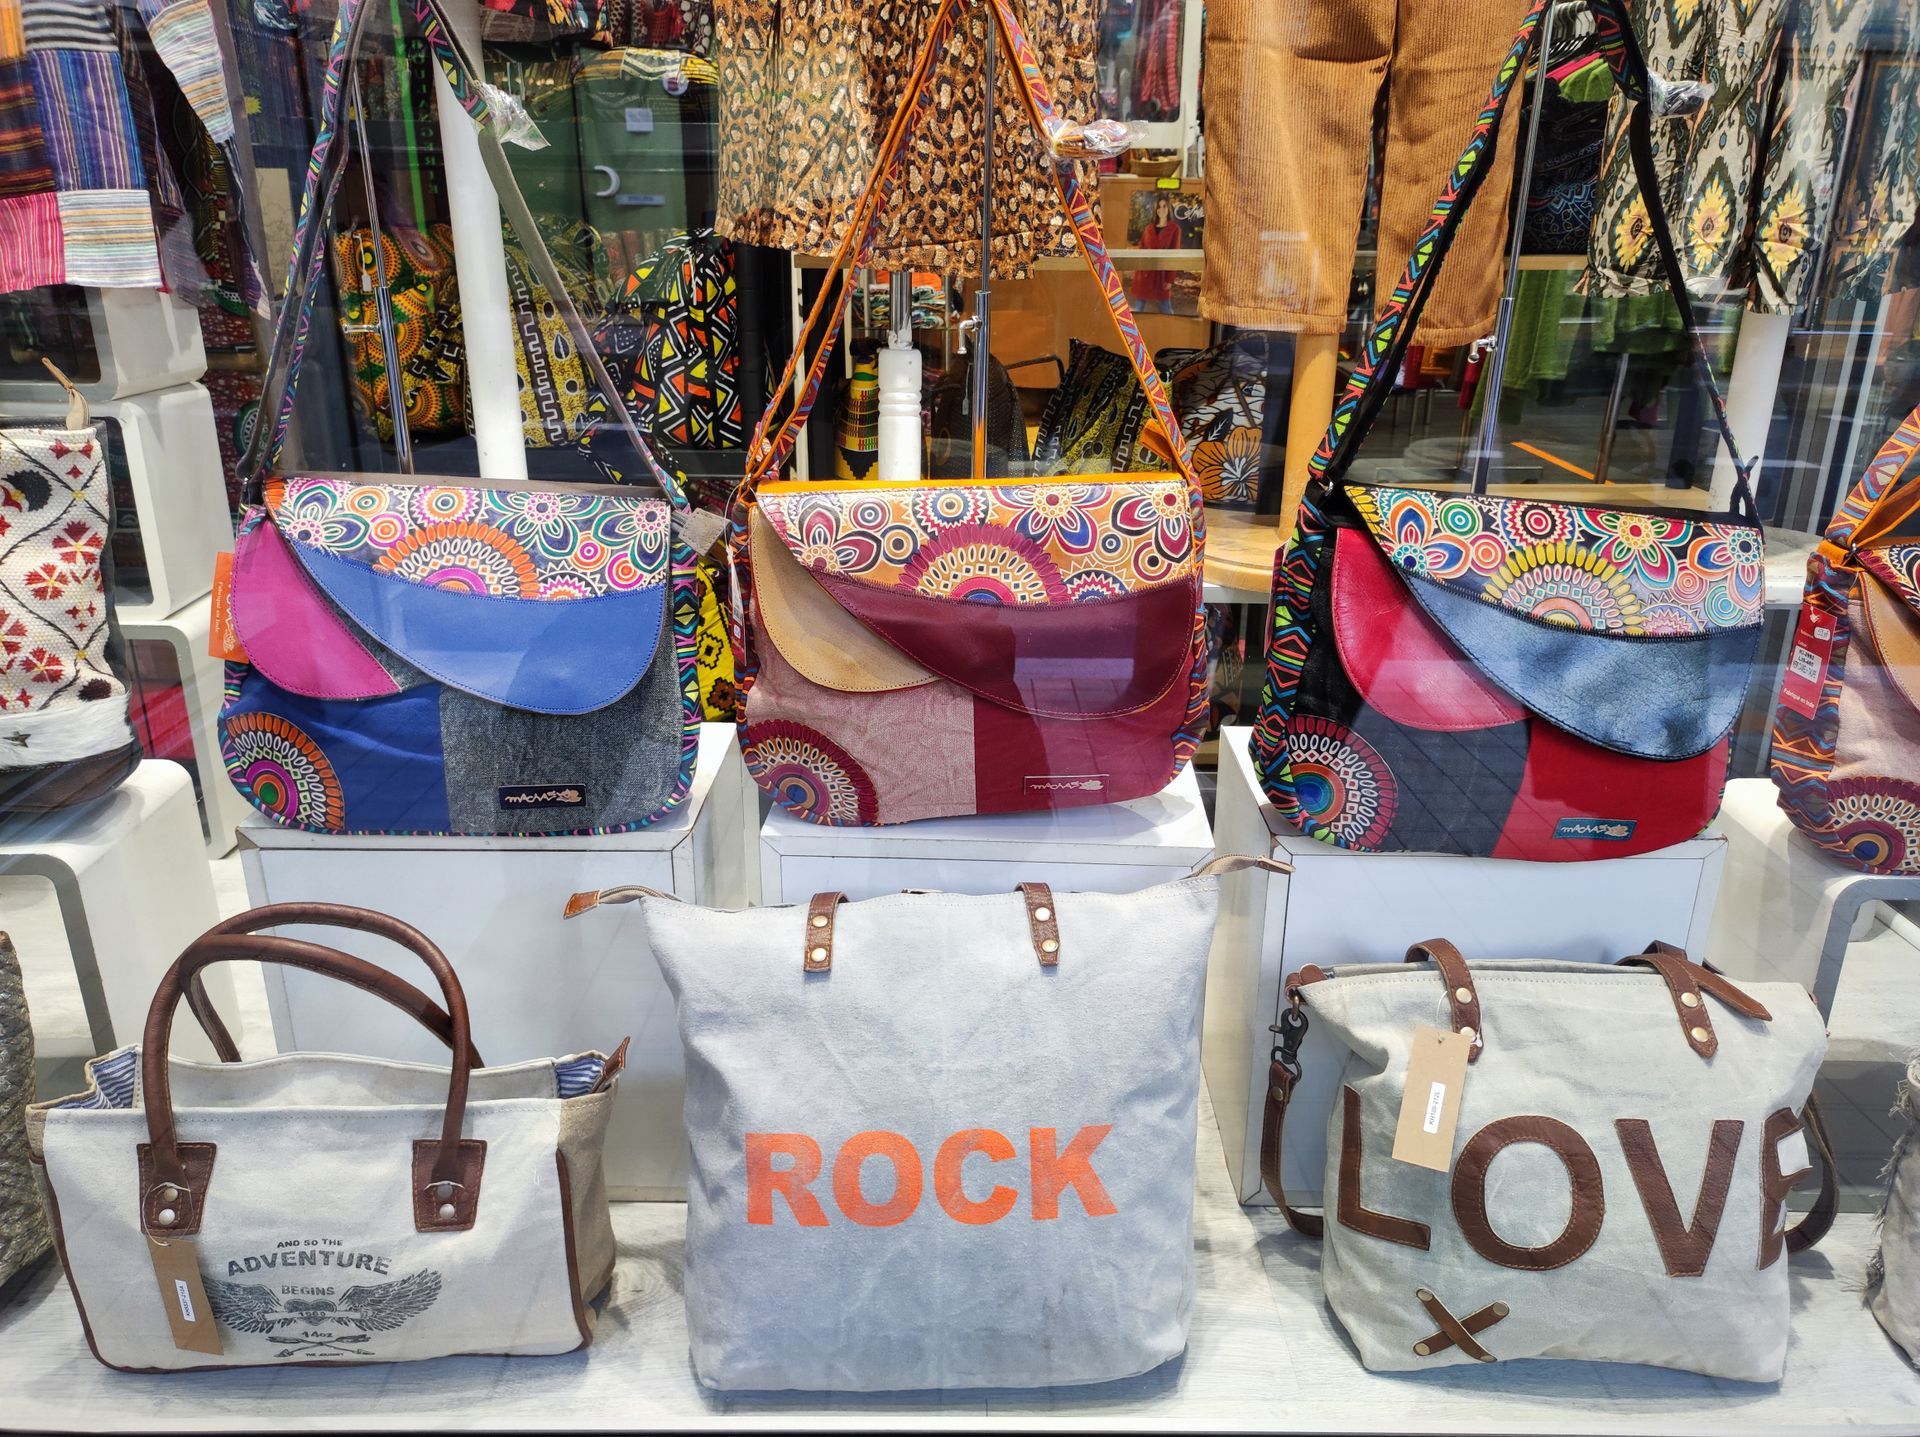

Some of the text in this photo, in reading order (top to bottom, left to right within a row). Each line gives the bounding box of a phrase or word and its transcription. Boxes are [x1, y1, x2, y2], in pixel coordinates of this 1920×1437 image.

[744, 1123, 1119, 1228] ROCK
[1337, 1084, 1813, 1278] LOVE
[277, 1238, 344, 1249] AND SO THE
[228, 1250, 393, 1277] ADVENTURE
[281, 1285, 336, 1296] BEGINS
